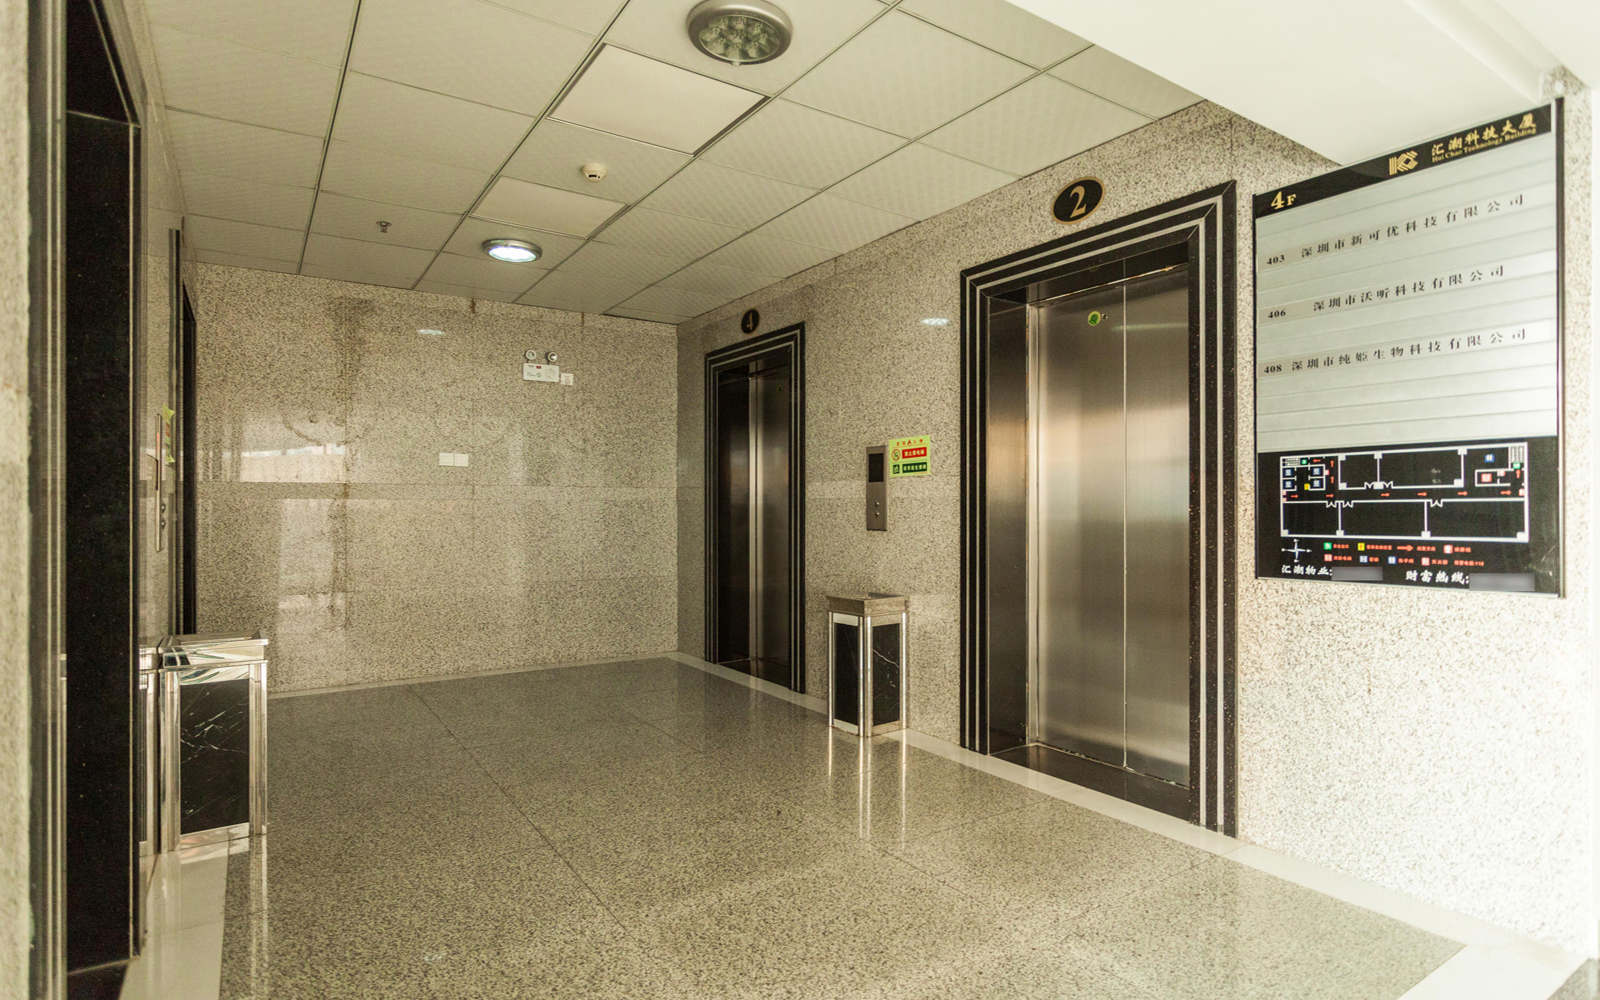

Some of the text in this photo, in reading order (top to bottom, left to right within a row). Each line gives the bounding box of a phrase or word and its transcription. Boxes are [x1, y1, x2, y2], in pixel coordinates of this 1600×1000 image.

[1431, 113, 1537, 156] 汇潮科技大厦
[1432, 128, 1537, 163] Hui Chao Technology Building
[1069, 185, 1087, 219] 2
[1267, 194, 1524, 266] 403 深圳市新可优科技有限公司
[745, 312, 754, 331] 4
[1268, 309, 1287, 320] 406
[1264, 364, 1283, 374] 408
